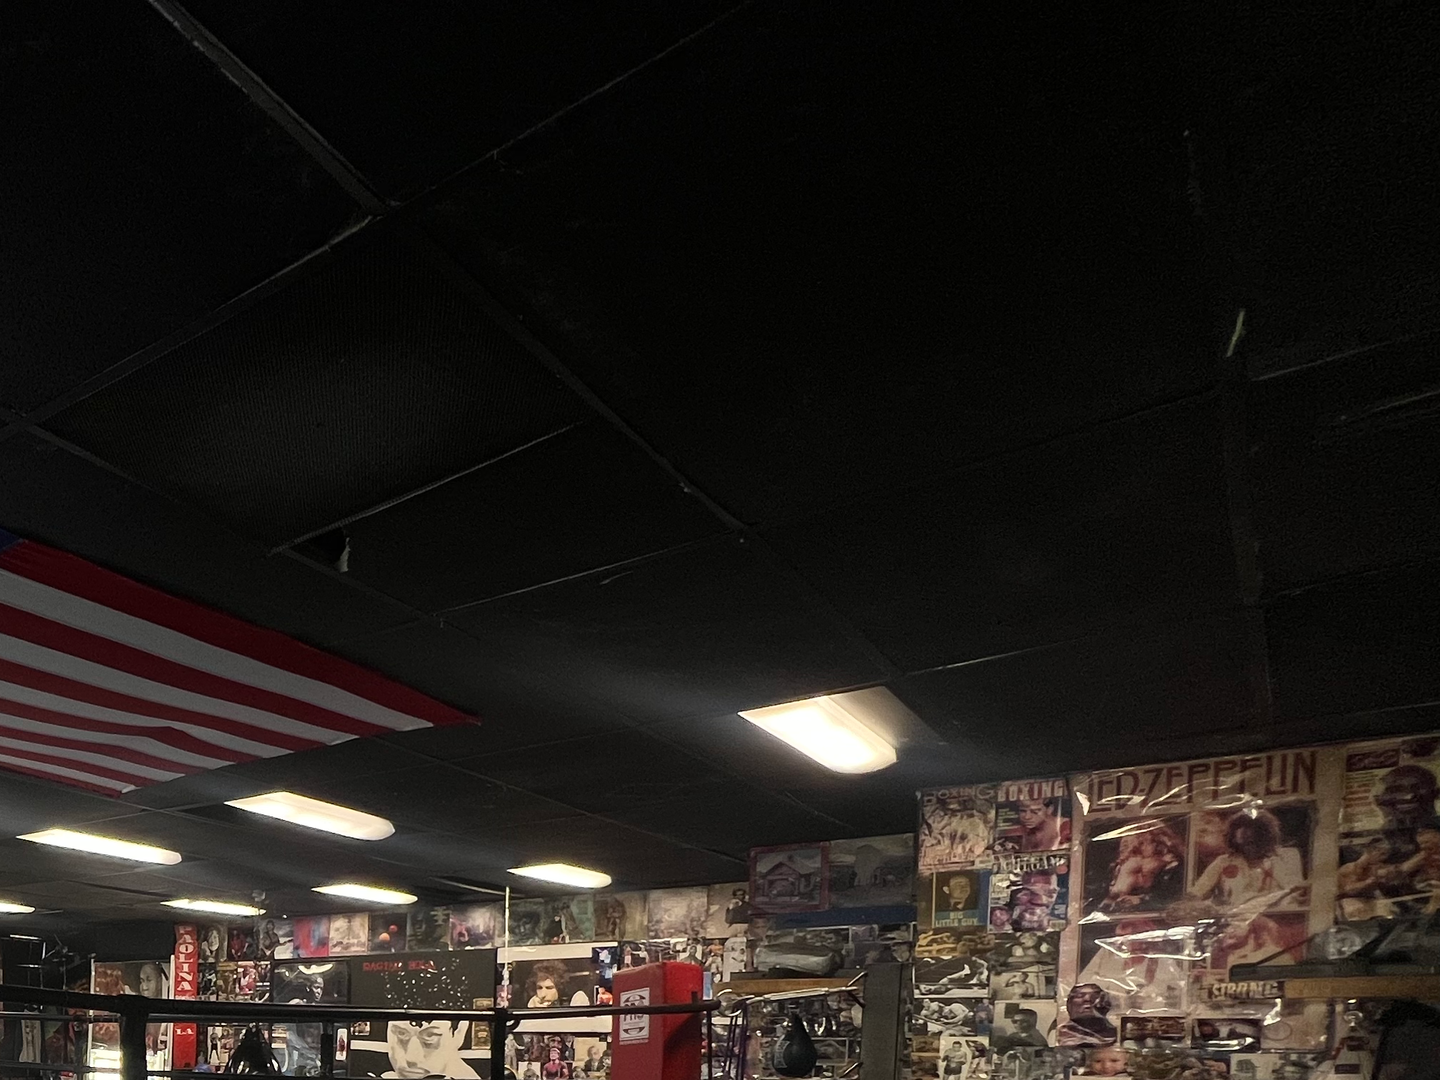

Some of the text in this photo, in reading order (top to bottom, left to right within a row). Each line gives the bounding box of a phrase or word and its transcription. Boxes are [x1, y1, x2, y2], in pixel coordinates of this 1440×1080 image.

[923, 784, 996, 801] BOXING
[997, 780, 1068, 802] BOXING
[949, 911, 964, 920] BIG
[935, 918, 978, 928] LITTLE GUY
